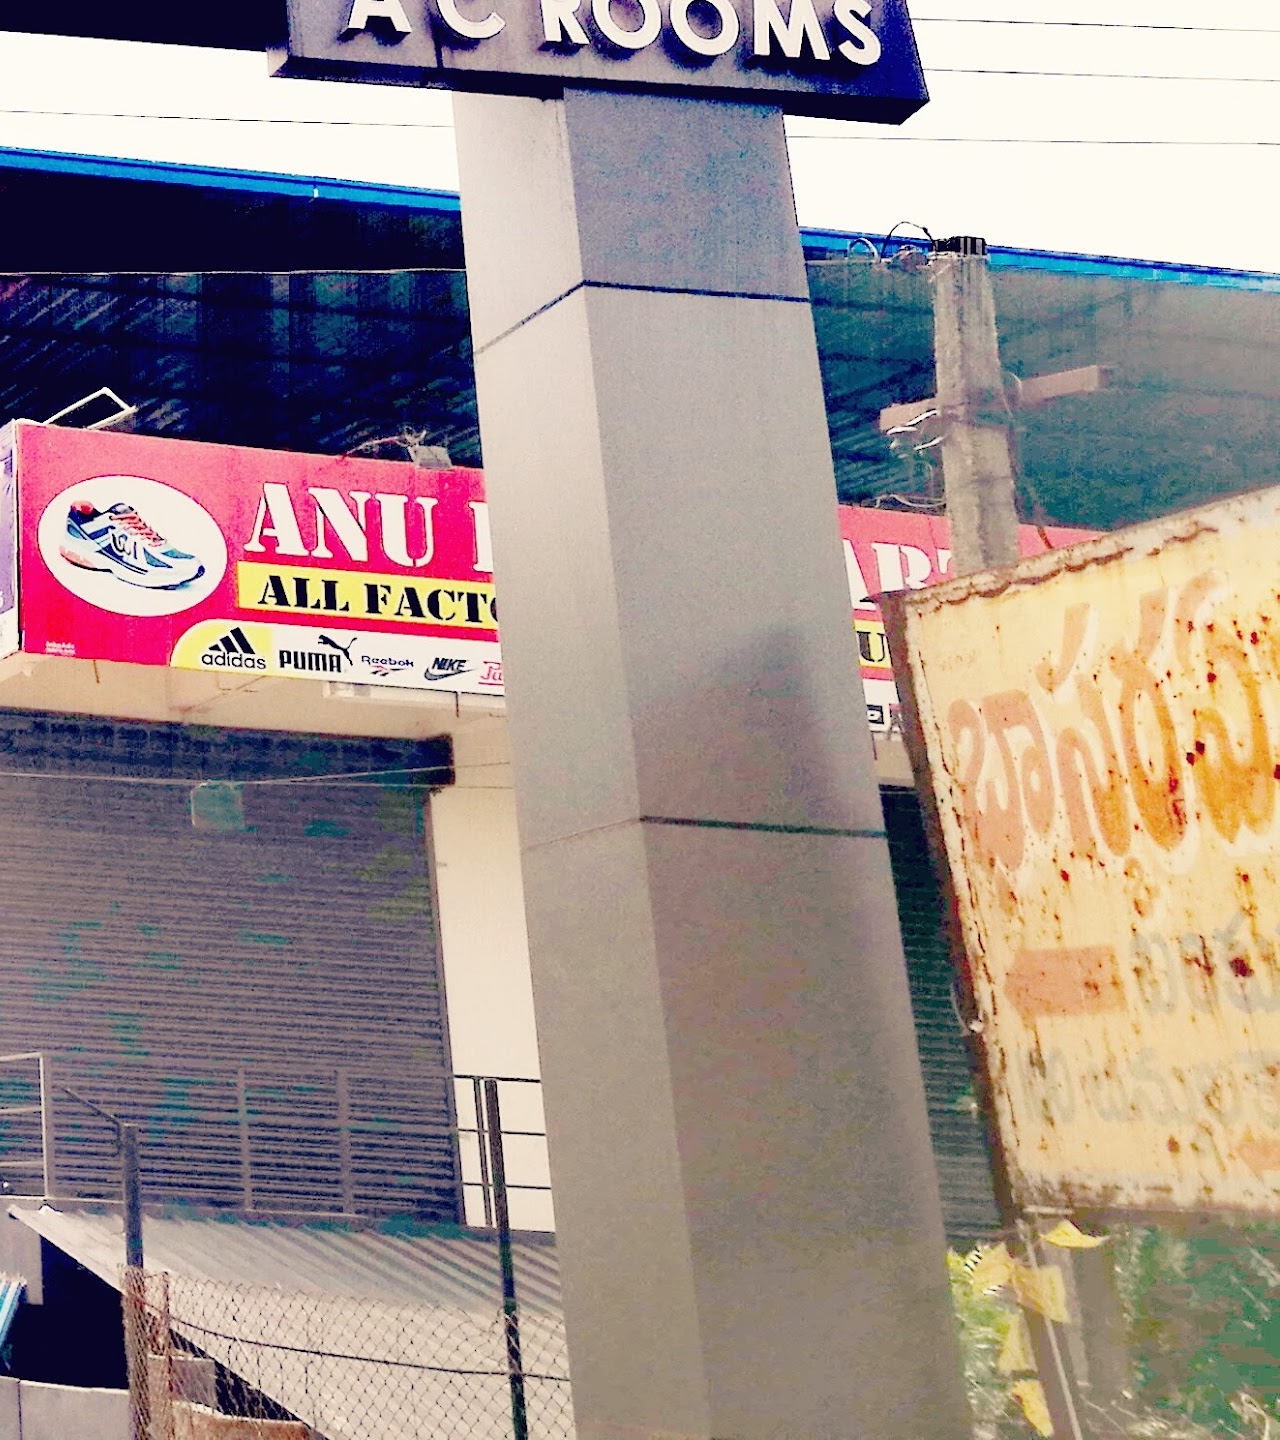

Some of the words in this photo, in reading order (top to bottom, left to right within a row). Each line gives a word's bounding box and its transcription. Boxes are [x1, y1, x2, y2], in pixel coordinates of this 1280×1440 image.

[244, 481, 438, 569] ANU
[259, 574, 349, 613] ALL
[364, 582, 499, 624] FACT
[202, 651, 266, 669] adidas
[279, 650, 341, 673] PUMA
[431, 657, 467, 672] NIKE
